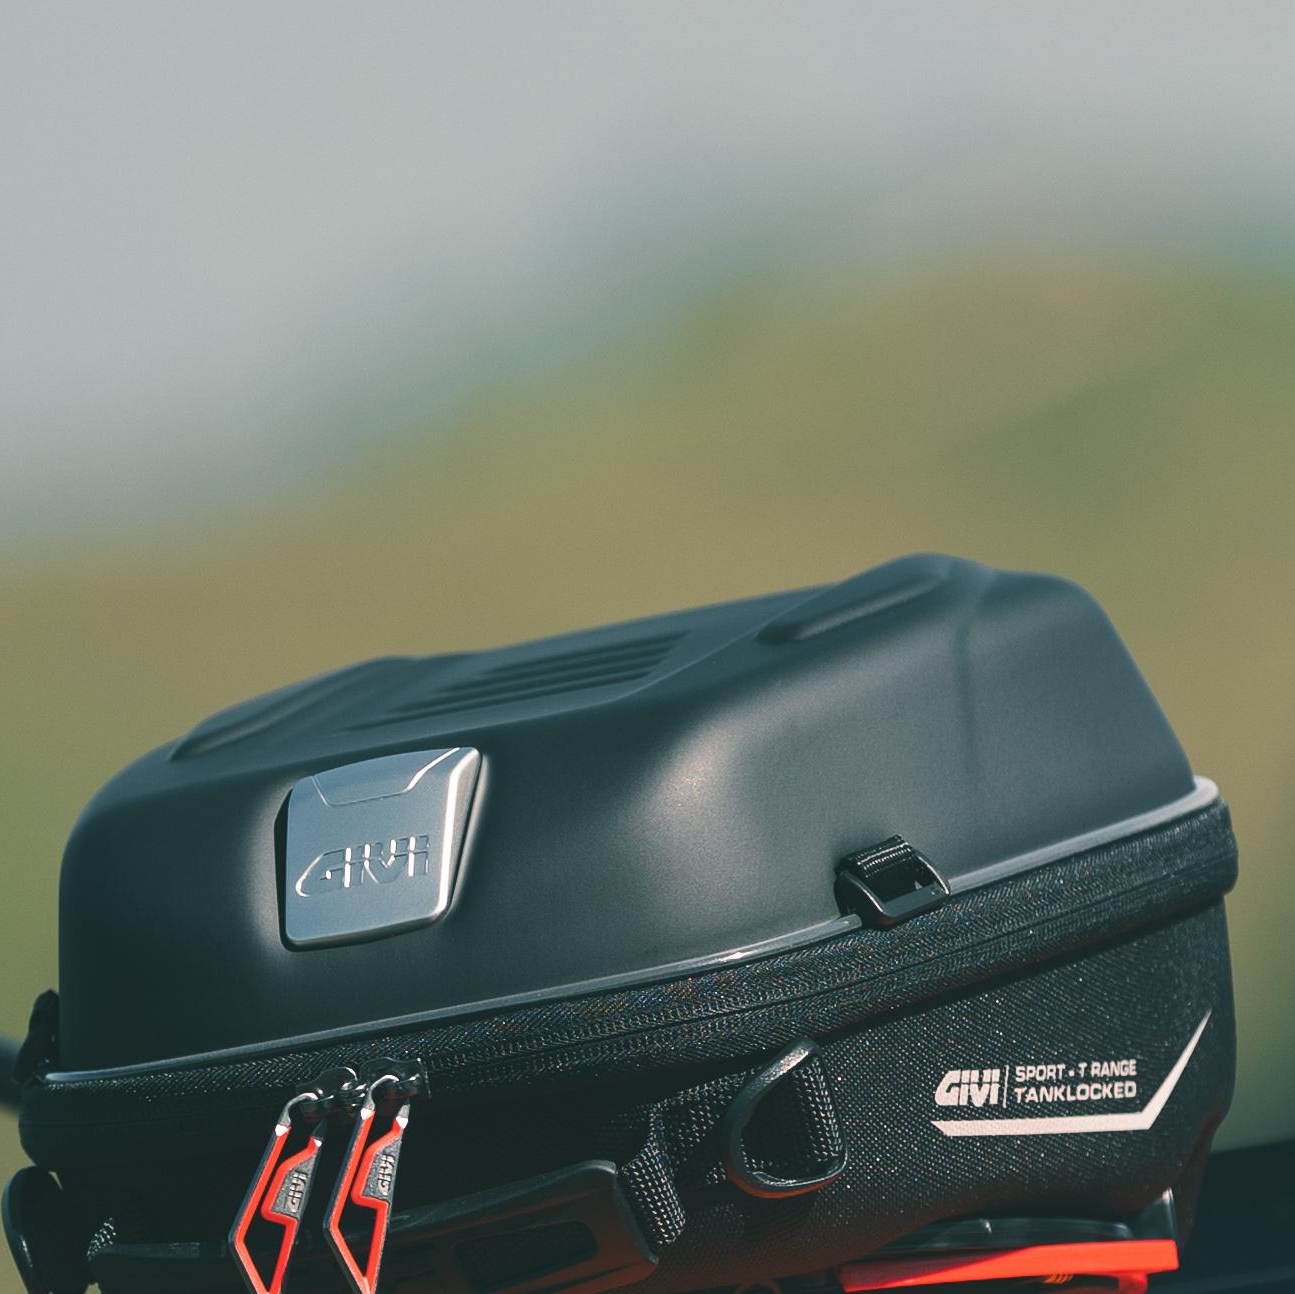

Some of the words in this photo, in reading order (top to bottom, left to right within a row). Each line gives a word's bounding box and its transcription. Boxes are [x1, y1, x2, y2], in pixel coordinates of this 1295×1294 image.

[295, 834, 430, 898] GIVI
[934, 1068, 1001, 1107] GIVI
[1015, 1064, 1066, 1083] SPORT
[1078, 1062, 1087, 1077] T
[1091, 1059, 1137, 1077] RANGE
[1014, 1080, 1137, 1104] TANKLOCKED
[287, 1170, 309, 1213] GIVI
[377, 1153, 395, 1196] GIVI
